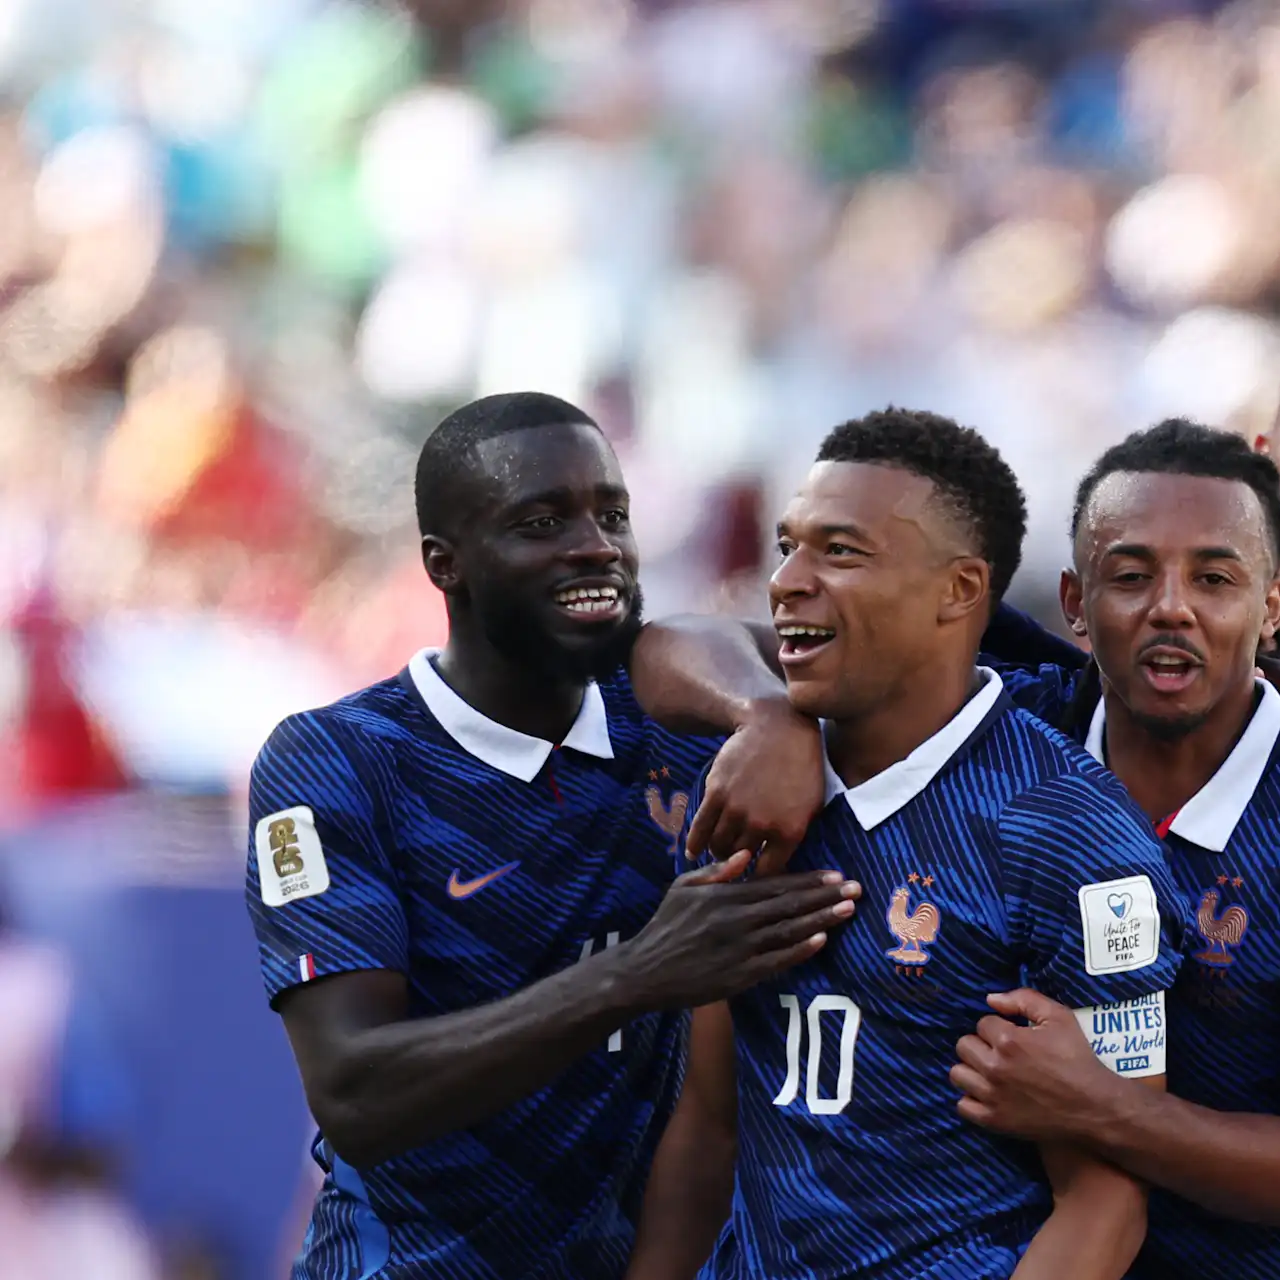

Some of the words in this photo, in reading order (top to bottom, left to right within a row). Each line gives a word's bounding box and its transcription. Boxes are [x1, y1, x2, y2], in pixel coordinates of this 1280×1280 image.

[281, 881, 310, 896] 2026
[1103, 920, 1127, 938] Unite
[1128, 917, 1141, 934] For
[1107, 933, 1140, 953] PEACE
[1115, 952, 1135, 962] FIFA
[1092, 1006, 1163, 1035] UNITES
[1090, 1036, 1121, 1056] the
[1123, 1030, 1165, 1054] World
[771, 992, 862, 1116] 10
[1118, 1057, 1148, 1071] FIFA
